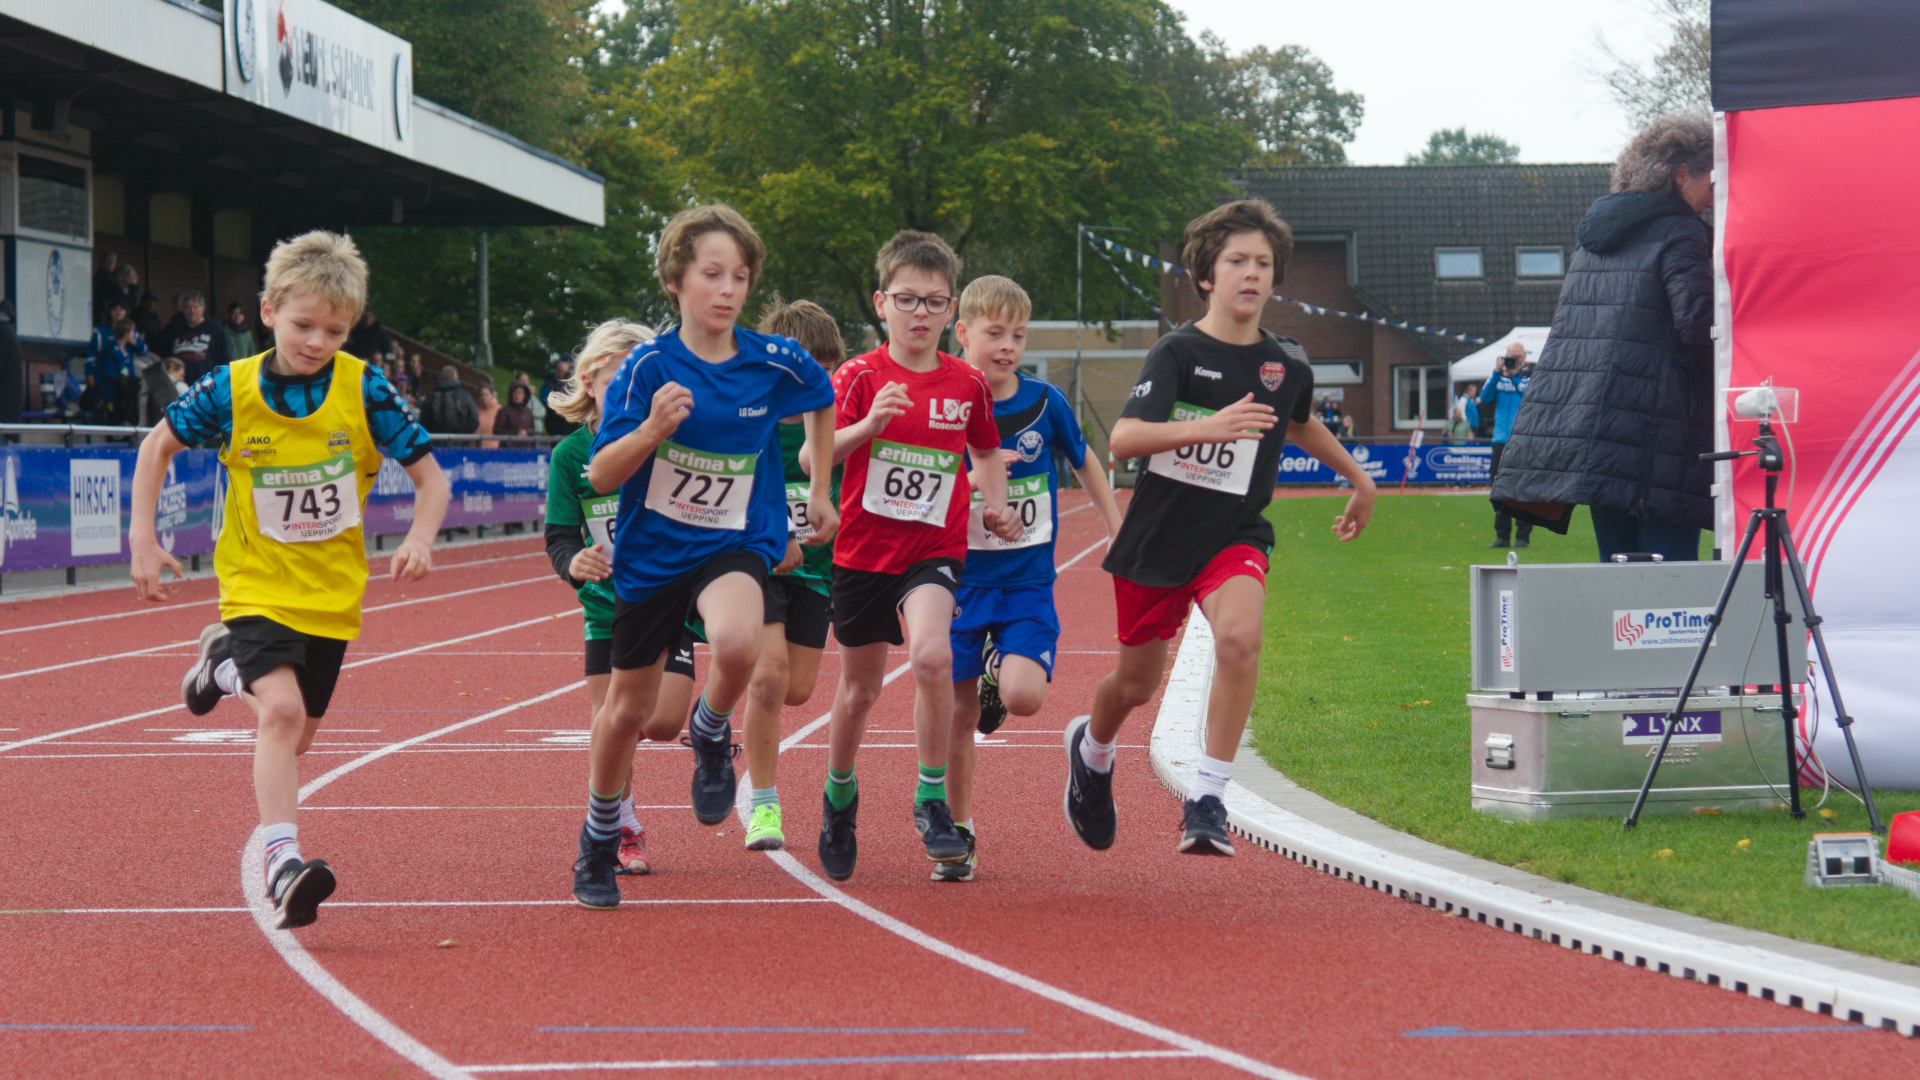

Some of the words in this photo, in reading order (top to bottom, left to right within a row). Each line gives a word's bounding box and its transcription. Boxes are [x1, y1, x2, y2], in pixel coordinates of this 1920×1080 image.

[1194, 366, 1222, 380] Kempa
[1174, 406, 1212, 421] eri
[246, 436, 271, 444] JAKO
[667, 447, 725, 472] erima
[881, 446, 936, 468] erima
[262, 469, 323, 486] erima
[1180, 461, 1232, 479] INTERSPORT
[1186, 471, 1222, 486] UEPPING
[670, 467, 735, 508] 727
[884, 466, 943, 503] 687
[73, 475, 114, 515] HIRSCH
[275, 483, 341, 522] 743
[675, 502, 729, 516] INTERSPORT
[681, 511, 719, 524] UEPPING
[291, 512, 343, 530] INTERSPORT
[300, 526, 337, 538] UEPPING
[1648, 716, 1703, 733] LYNX
